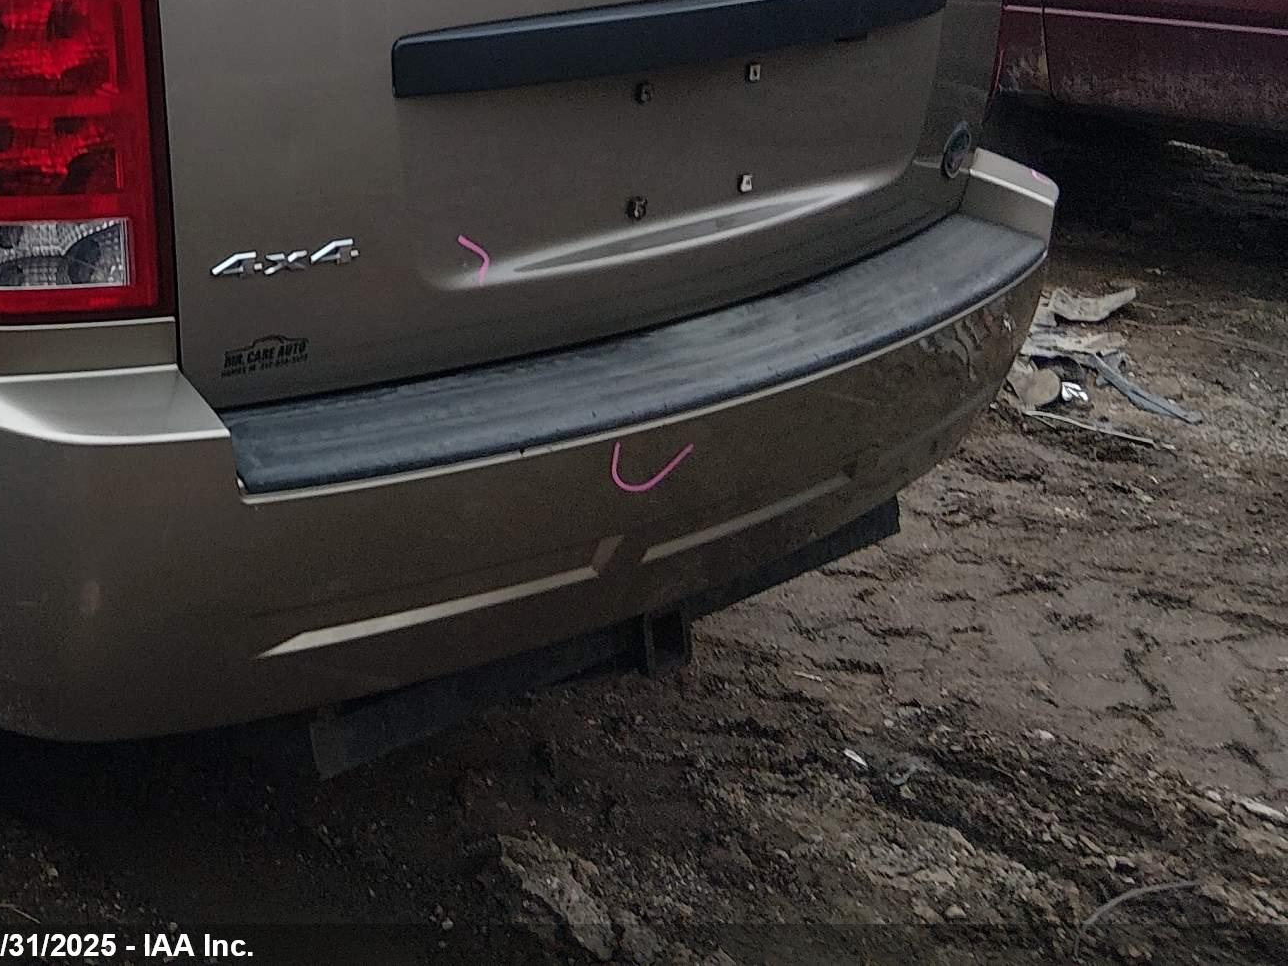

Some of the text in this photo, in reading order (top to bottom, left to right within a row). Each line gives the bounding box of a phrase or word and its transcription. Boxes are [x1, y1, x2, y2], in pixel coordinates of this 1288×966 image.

[211, 238, 359, 277] 4x4
[247, 345, 276, 364] CARE
[277, 340, 307, 359] AUTO
